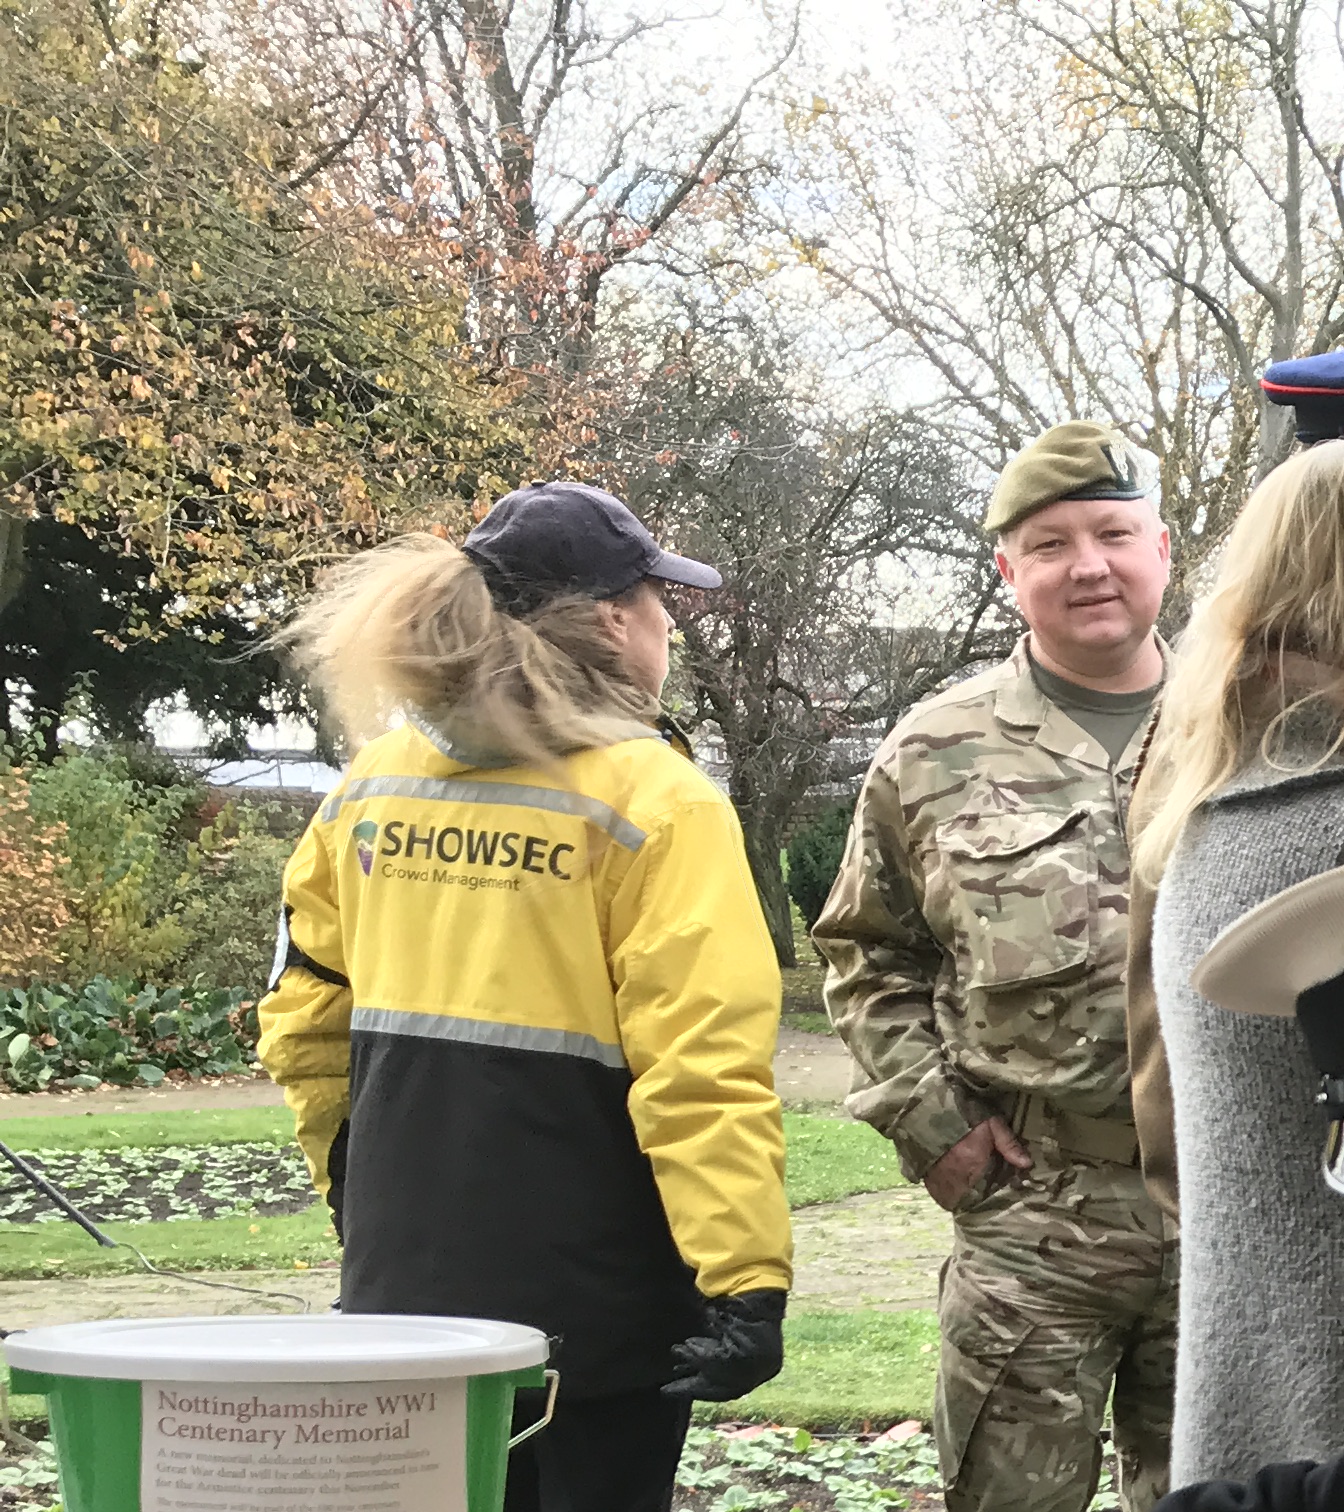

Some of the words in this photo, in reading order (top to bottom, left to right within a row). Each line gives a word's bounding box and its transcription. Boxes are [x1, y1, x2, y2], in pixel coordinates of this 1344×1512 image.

[381, 821, 576, 881] SHOWSEC
[381, 863, 430, 882] Crowd
[433, 869, 520, 892] Management
[158, 1390, 367, 1423] Nottinghamshire
[158, 1417, 286, 1449] Centenary
[294, 1418, 410, 1444] Memorial
